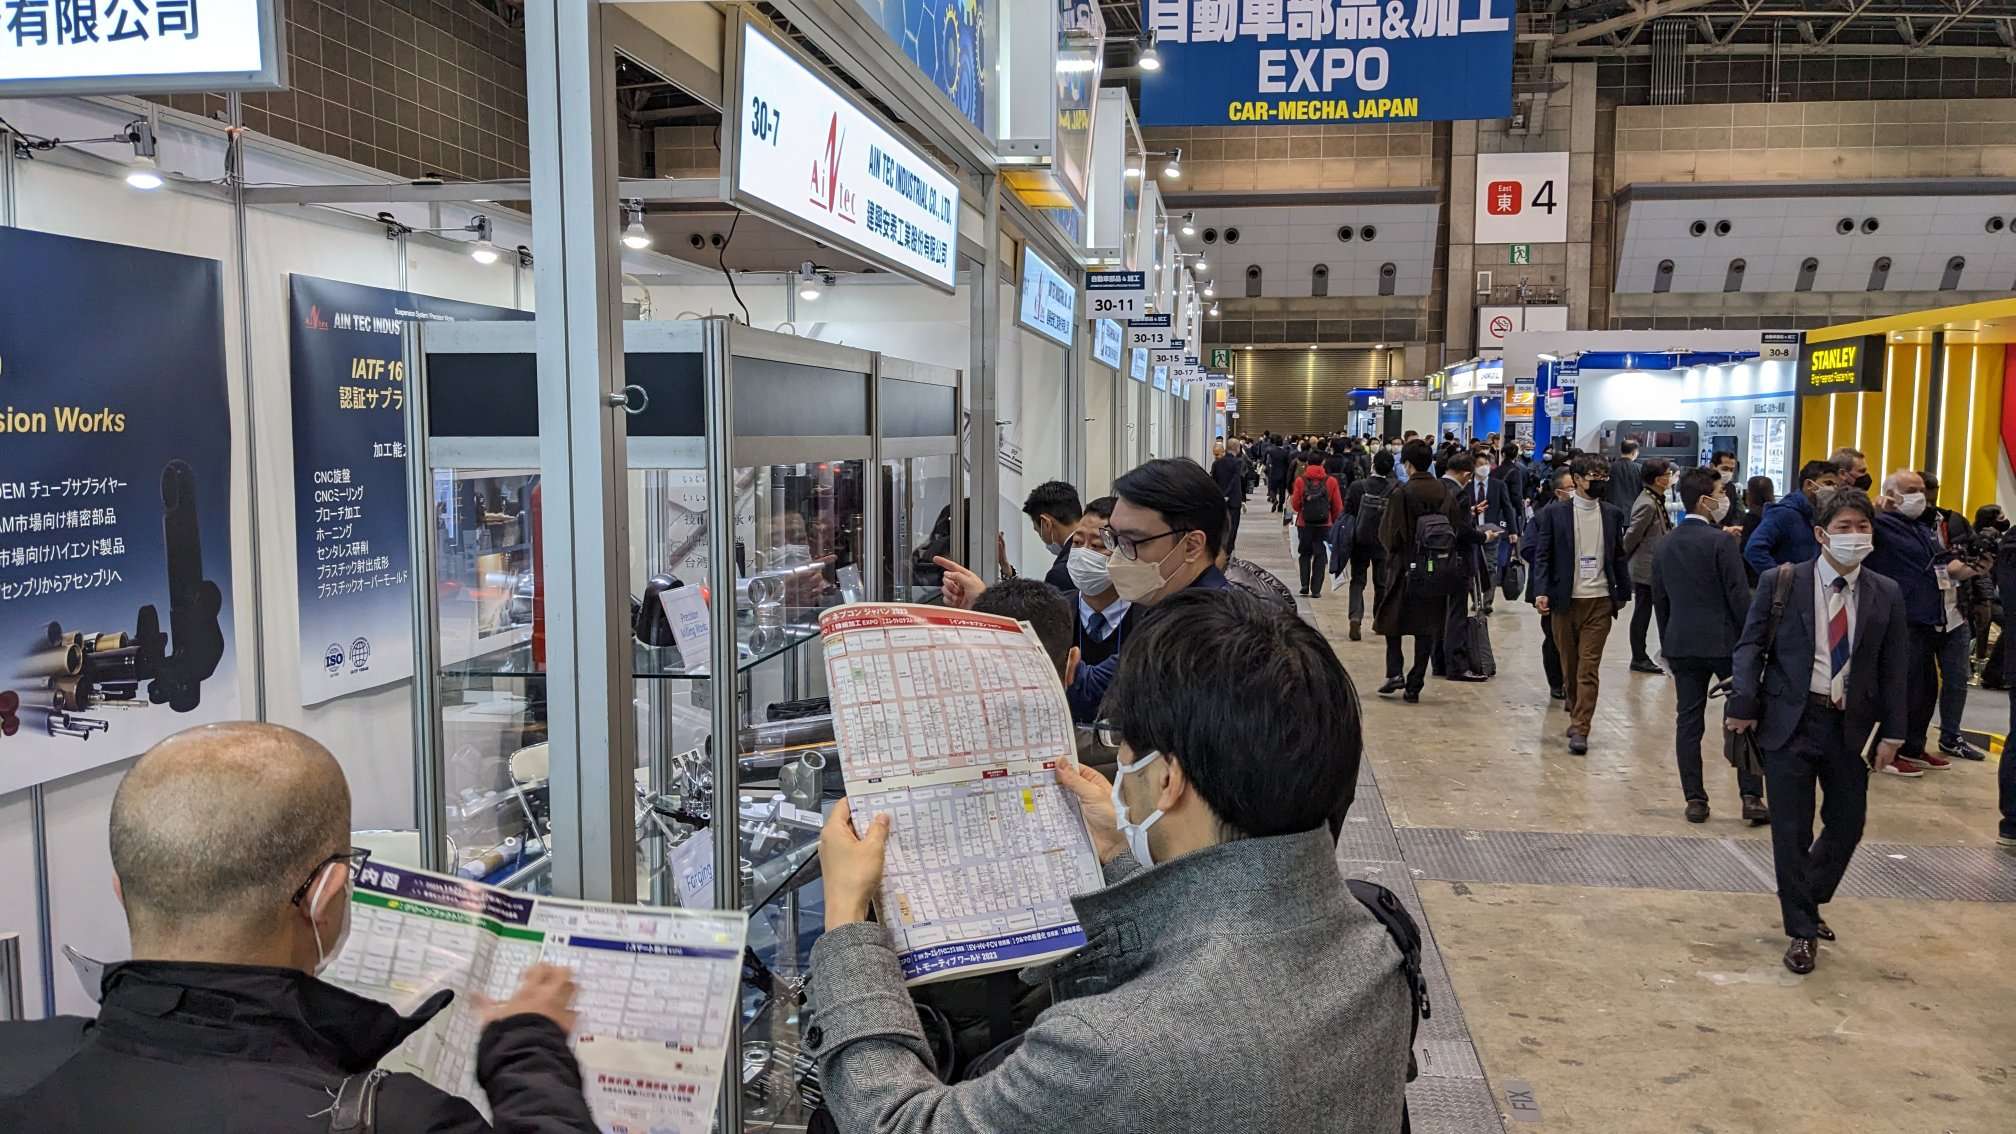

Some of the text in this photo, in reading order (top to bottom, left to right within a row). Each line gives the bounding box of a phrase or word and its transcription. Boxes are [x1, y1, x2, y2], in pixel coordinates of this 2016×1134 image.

[0, 0, 199, 47] 有限公司
[1149, 0, 1509, 43] 自動車部品&加工
[1258, 46, 1389, 93] EXPO
[1229, 98, 1418, 121] CAR-MECHA JAPAN
[751, 96, 780, 147] 30-7
[868, 143, 881, 180] AIN
[882, 151, 895, 189] TEC
[895, 162, 928, 211] INDUSTRIAL
[941, 195, 952, 225] LTD.
[1498, 184, 1512, 192] East
[1496, 180, 1557, 215] 東 4
[1095, 299, 1133, 311] 30-11
[333, 312, 352, 330] AIN
[352, 314, 372, 332] TEC
[1134, 333, 1164, 343] 30-13
[351, 358, 404, 381] IATF 16
[1811, 347, 1856, 370] STANLEY
[339, 386, 404, 410] 認証サプラ
[54, 406, 126, 432] Works
[0, 476, 128, 499] EM チューブサプライヤー
[314, 469, 351, 484] CNC旋盤
[315, 485, 364, 503] CNCミーリング
[0, 507, 117, 533] M市場向け精密部品
[316, 523, 353, 542] ホーニング
[316, 540, 369, 561] センタレス研削
[317, 556, 390, 581] プラスチック射出成形
[318, 570, 408, 600] プラスチックオーバーモールド
[832, 608, 862, 621] ネプコン
[864, 607, 890, 616] ジャパン
[326, 653, 343, 667] ISO
[687, 863, 713, 891] Forging
[957, 953, 980, 965] ワールド
[981, 951, 997, 961] 2023
[1507, 1090, 1537, 1110] FIX
